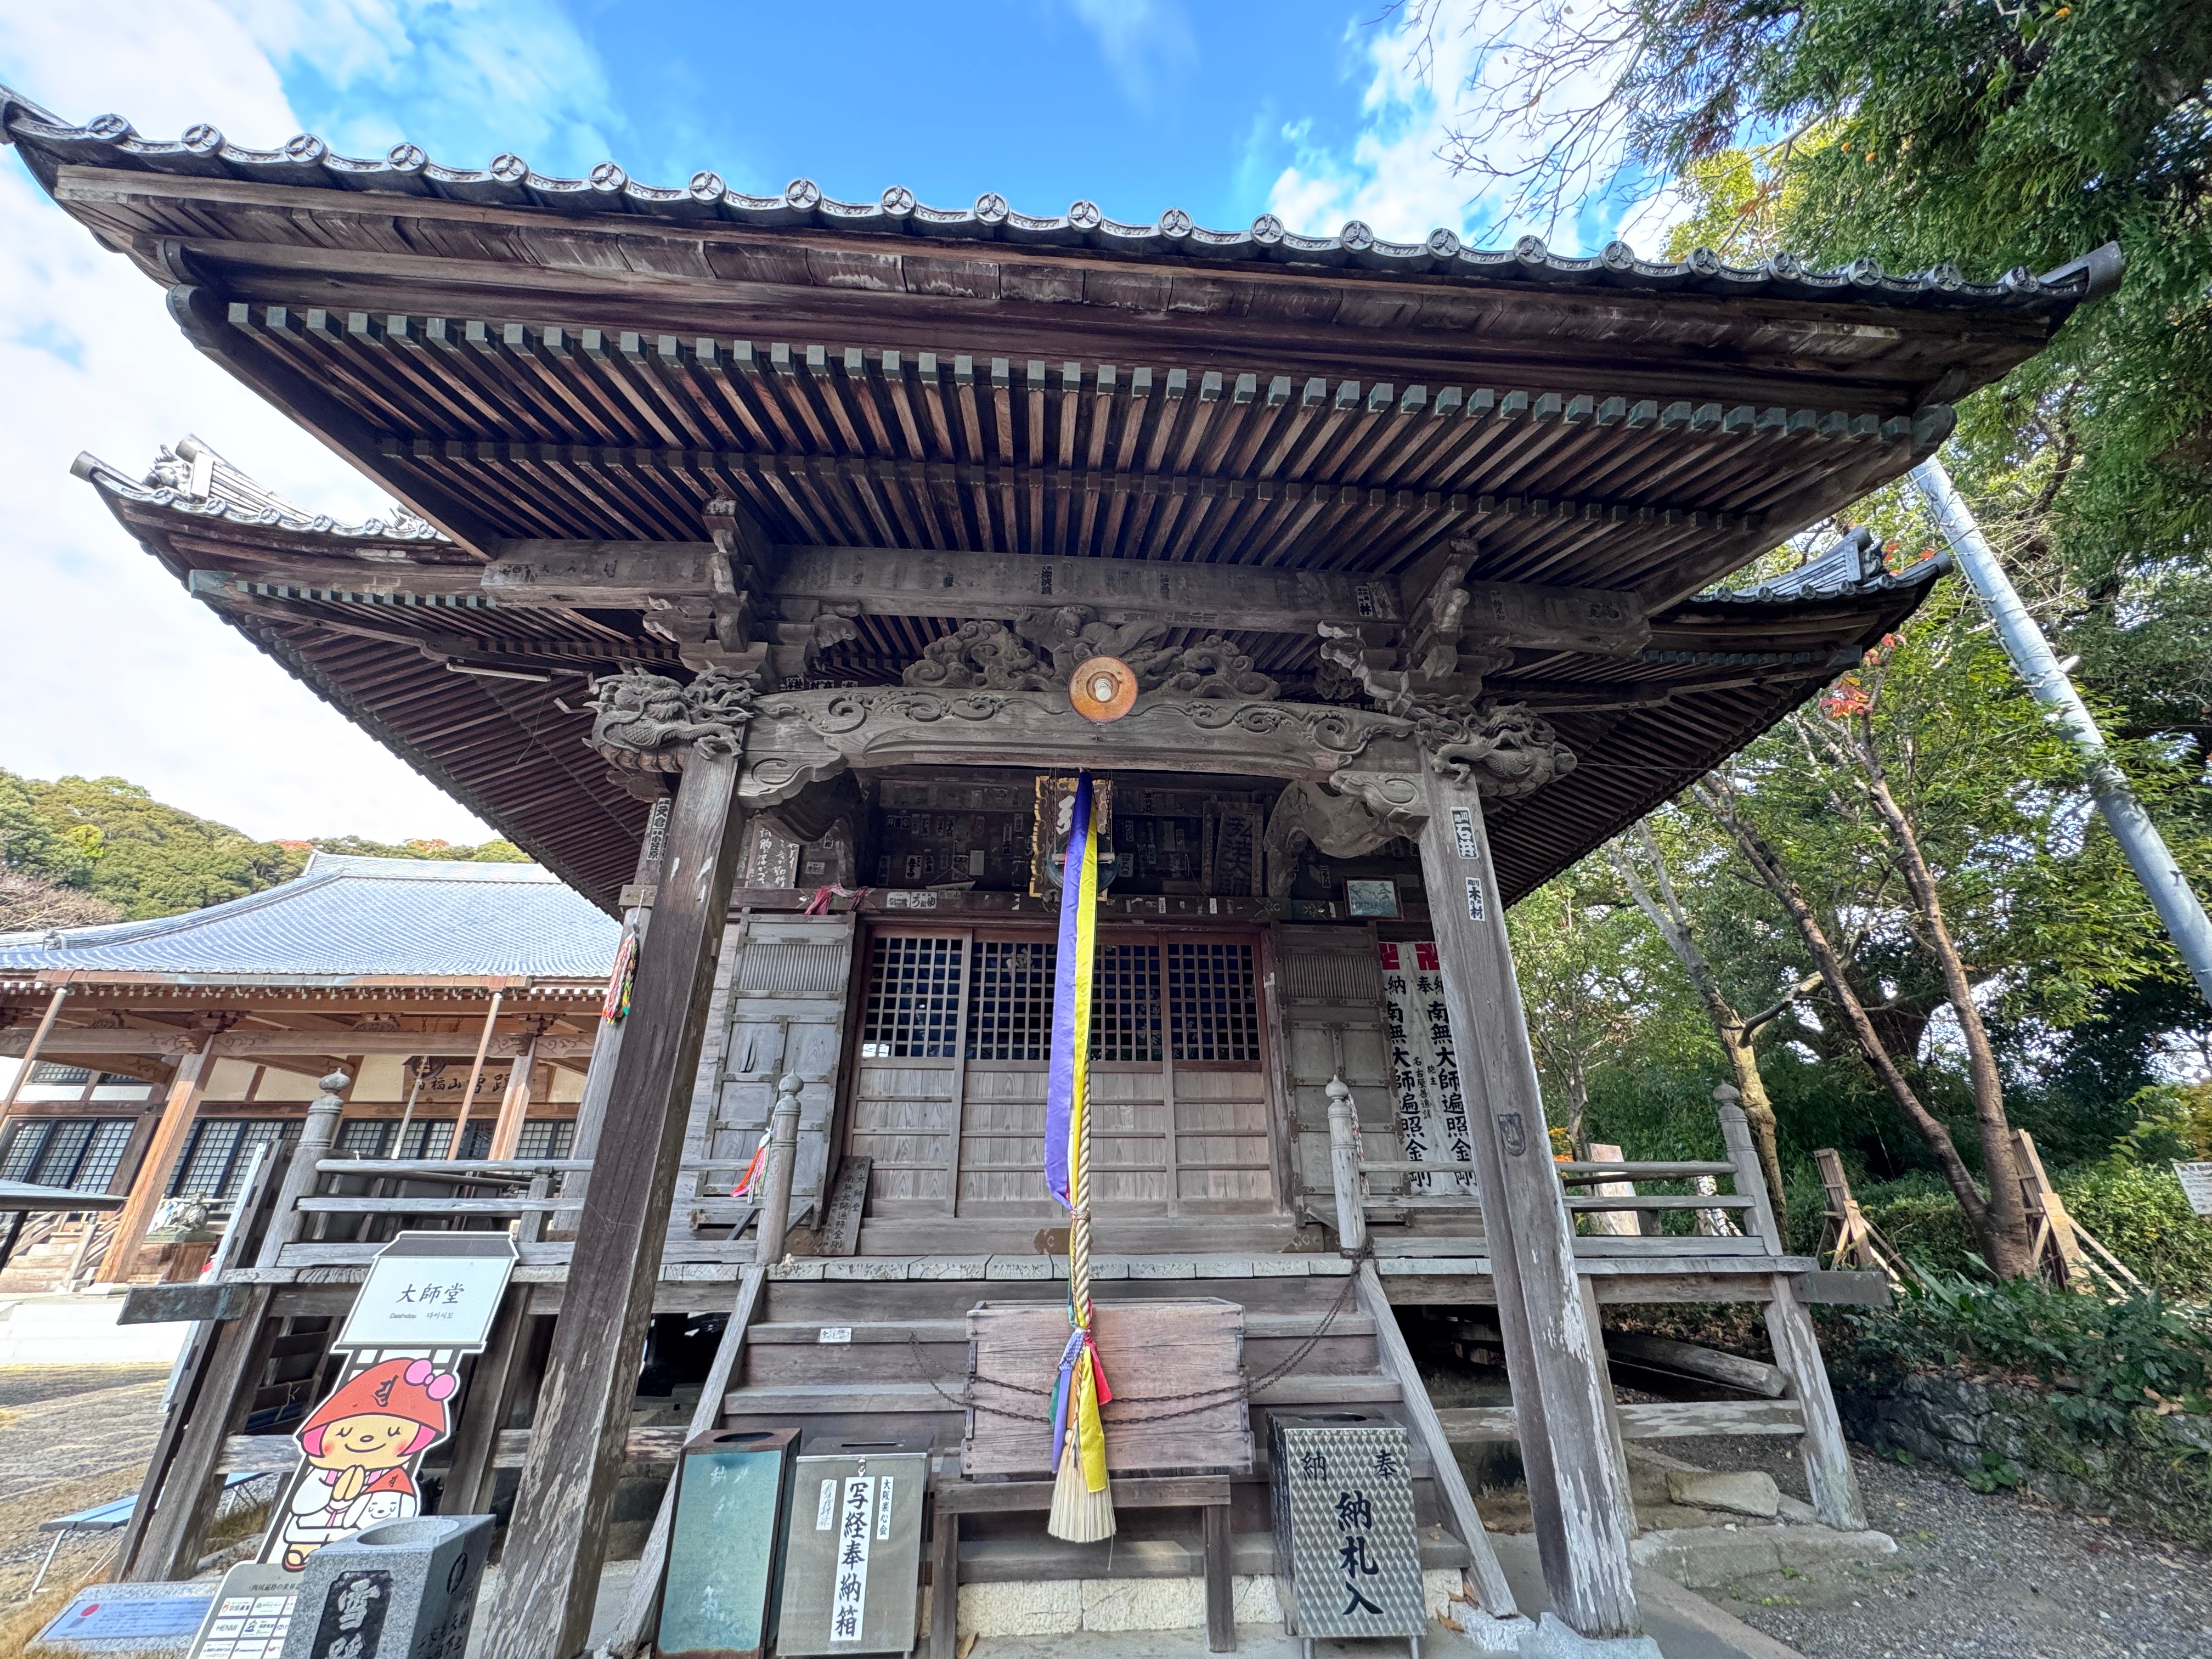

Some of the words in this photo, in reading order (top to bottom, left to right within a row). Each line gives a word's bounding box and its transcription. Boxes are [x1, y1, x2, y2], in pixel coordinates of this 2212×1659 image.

[1455, 823, 1476, 856] 石井
[1469, 887, 1483, 920] 木村
[1427, 1001, 1477, 1187] 南無大師遍照金剛
[851, 1173, 865, 1212] 大師堂
[396, 1283, 465, 1304] 大師堂
[879, 1479, 890, 1536] 大阪楽心会
[834, 1482, 868, 1637] 写経奉納箱
[1335, 1491, 1384, 1615] 納札入
